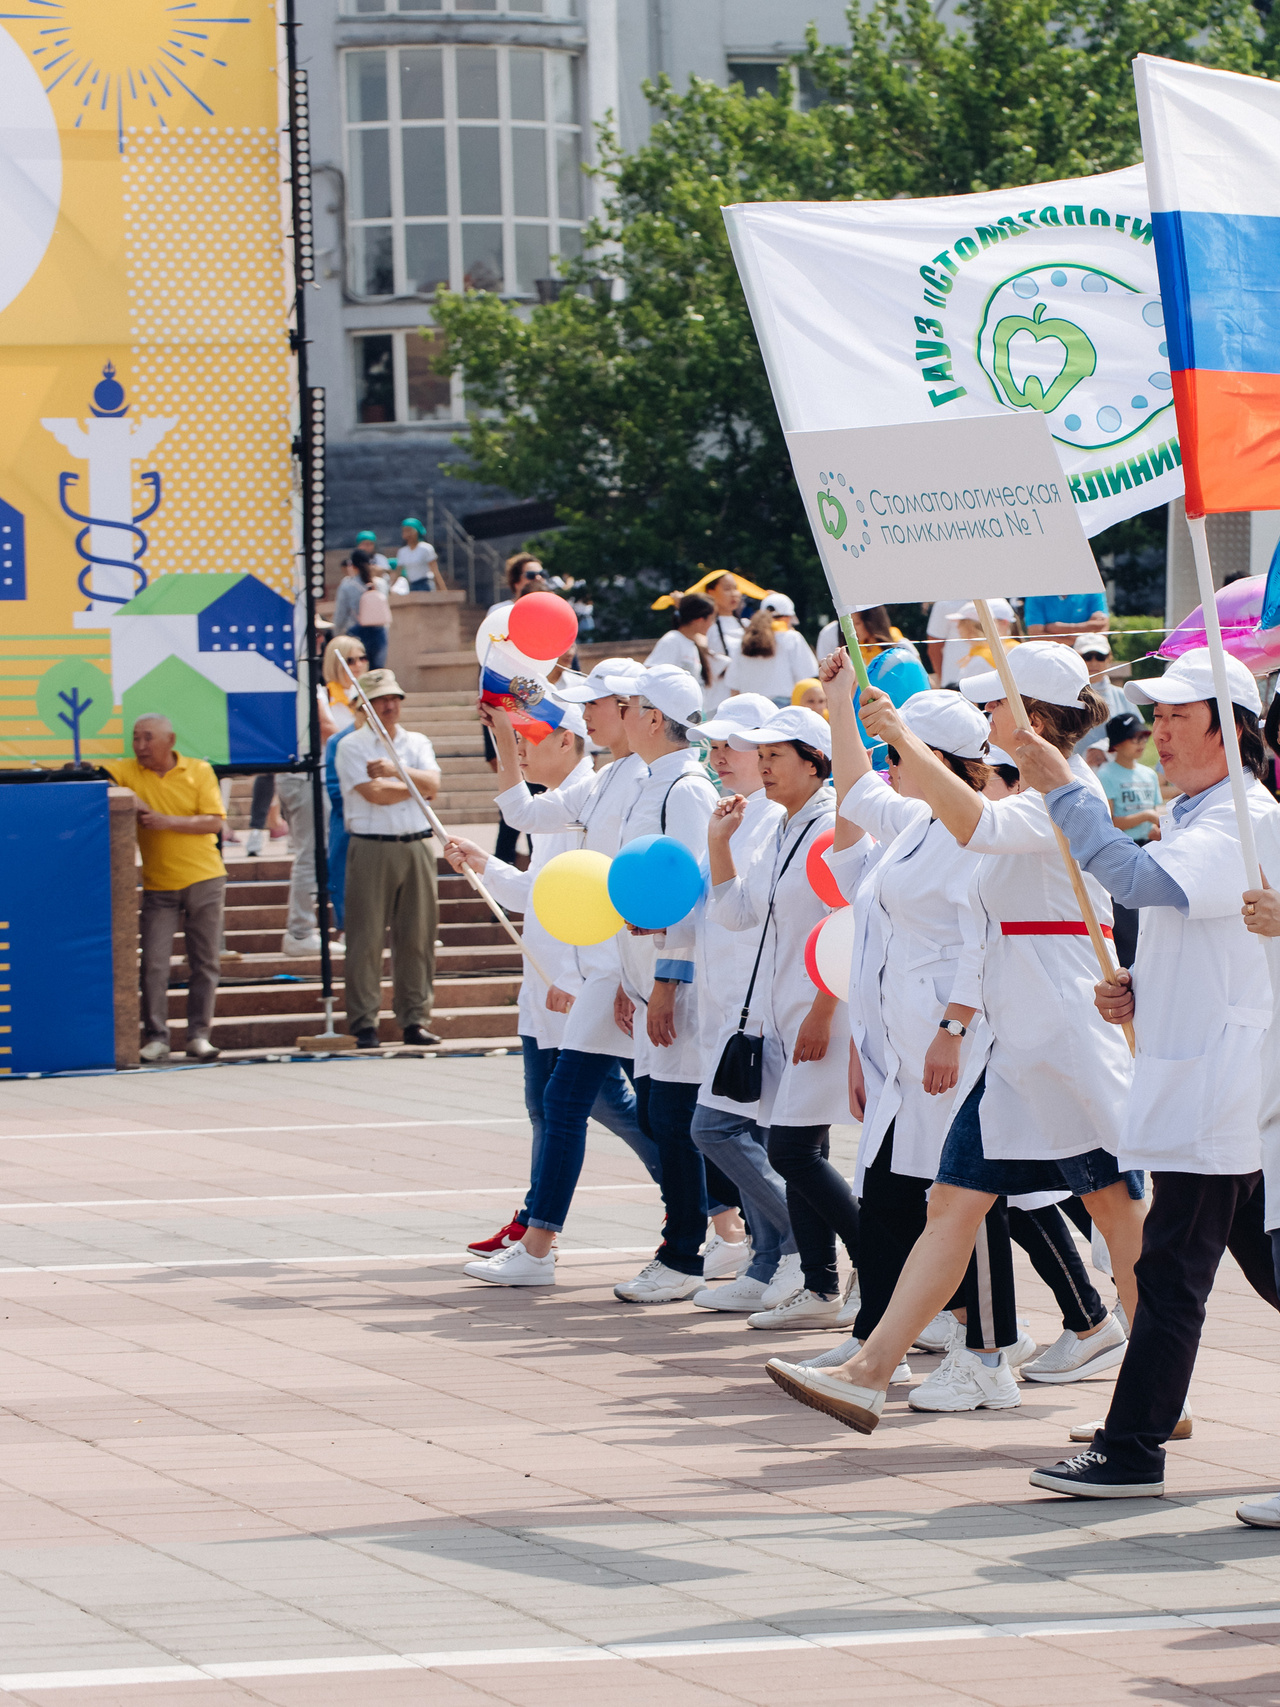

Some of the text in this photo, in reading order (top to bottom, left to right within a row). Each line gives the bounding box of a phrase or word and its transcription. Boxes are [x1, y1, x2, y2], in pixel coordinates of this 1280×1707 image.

[914, 315, 968, 408] ГАУЗ
[869, 483, 1063, 516] Стоматологическая
[880, 517, 1004, 545] поликлиника
